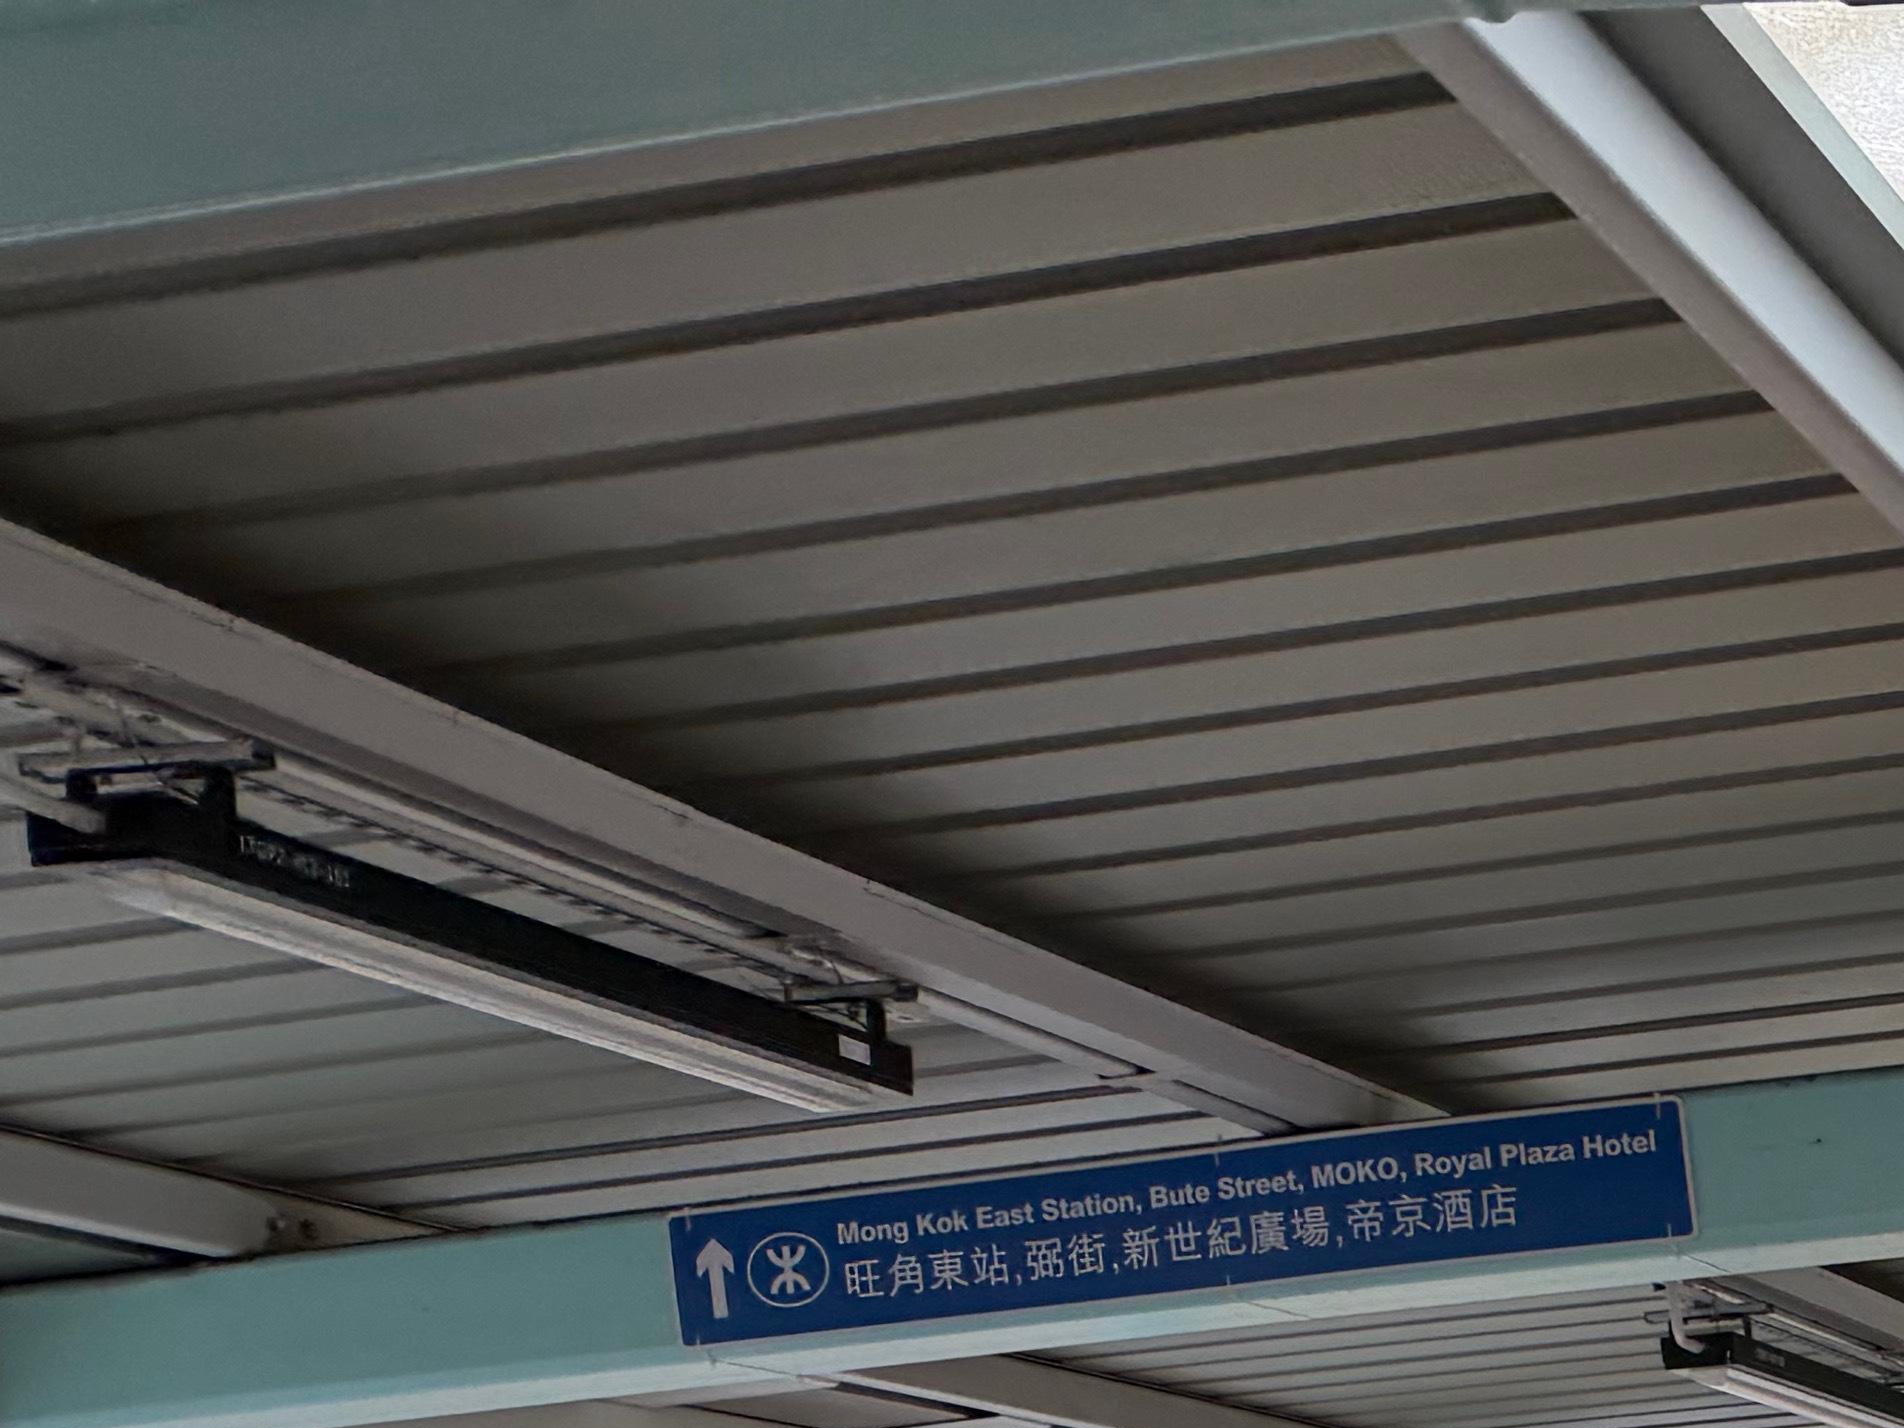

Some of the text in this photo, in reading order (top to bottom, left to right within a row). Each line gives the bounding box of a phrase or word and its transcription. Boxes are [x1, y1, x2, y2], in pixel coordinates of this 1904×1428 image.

[836, 1128, 1658, 1244] Mong Kok East Station, Bute Street, MOKO, Royal Plaza Hotel
